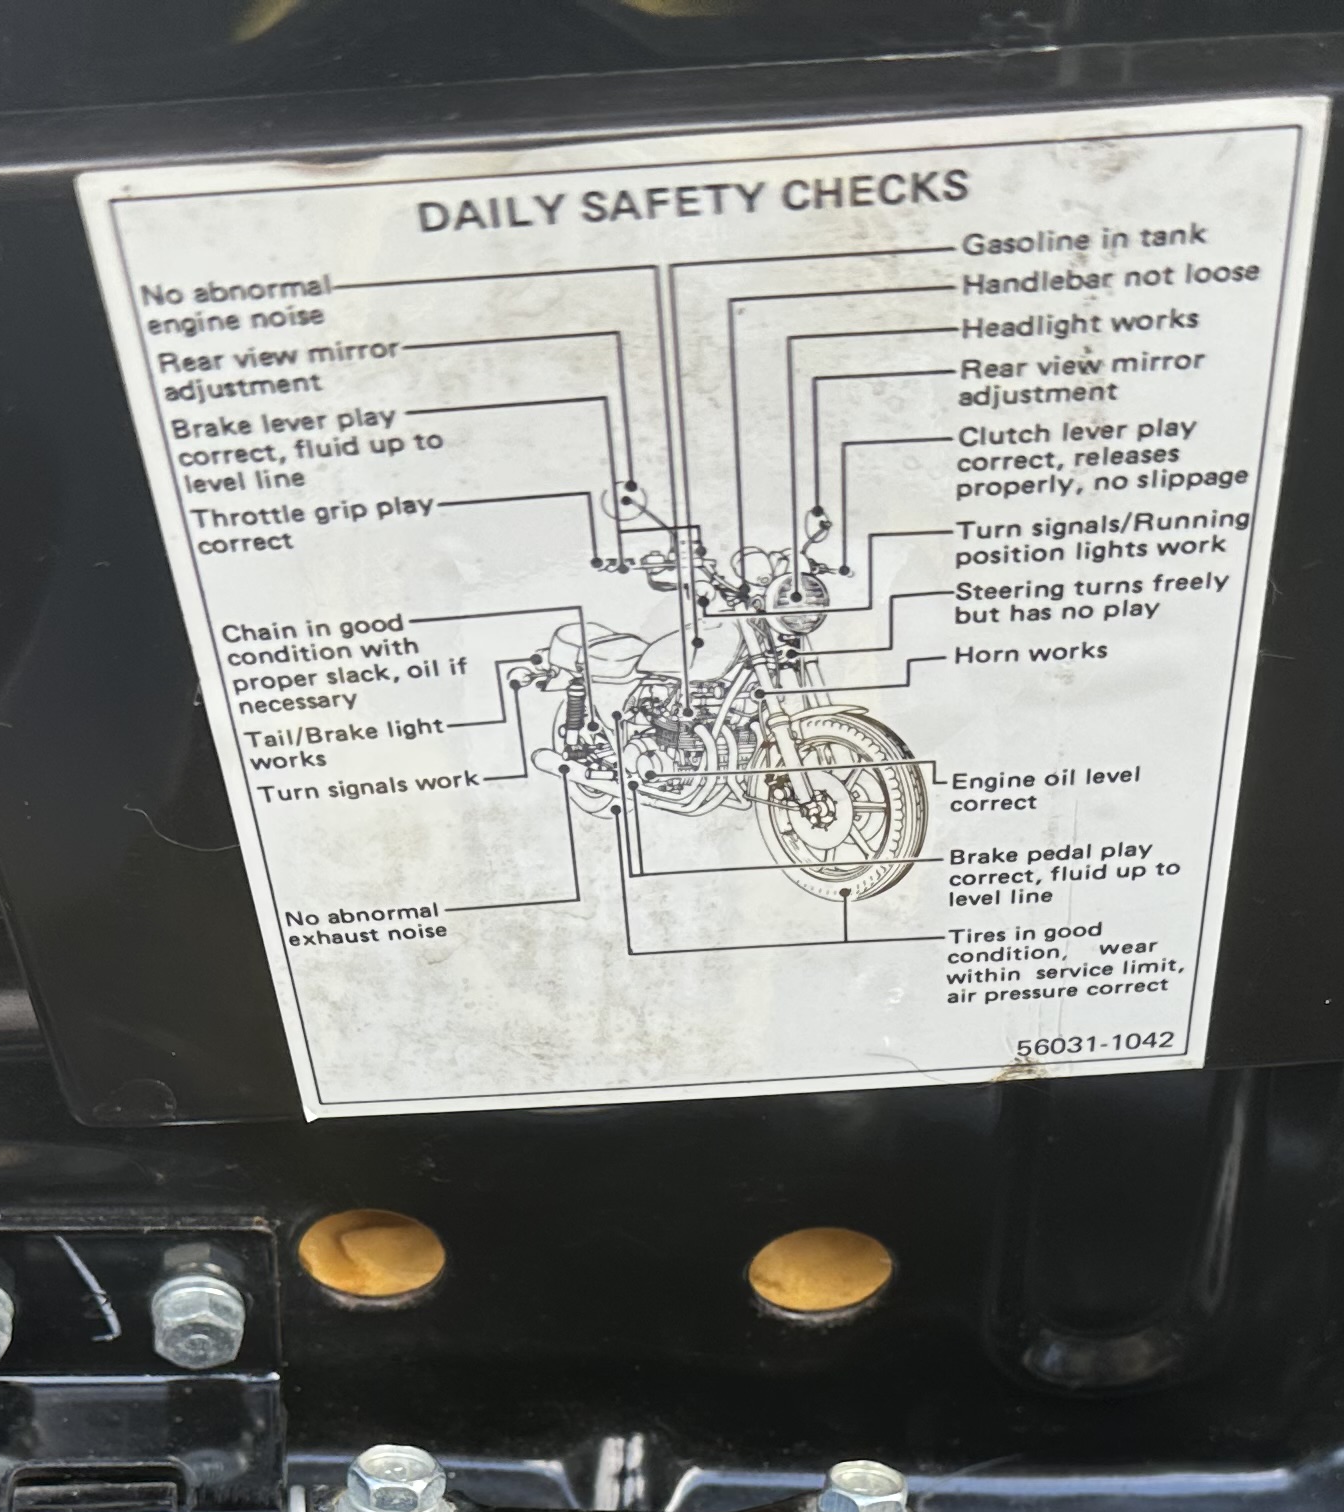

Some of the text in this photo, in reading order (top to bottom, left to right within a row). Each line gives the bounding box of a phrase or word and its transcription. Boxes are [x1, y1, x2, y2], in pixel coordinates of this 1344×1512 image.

[417, 169, 969, 233] DAILY SAFETY CHECKS
[962, 222, 1206, 257] Gasoline in tank
[140, 274, 334, 305] No abnormal
[963, 263, 1261, 295] Handlebar not loose
[149, 308, 325, 338] engine noise
[962, 307, 1199, 340] Headlight works
[158, 341, 399, 373] Rear view mirror
[961, 351, 1206, 380] Rear view mirror
[165, 374, 323, 404] adjustment
[958, 383, 1118, 410] adjustment
[171, 407, 396, 439] Brake lever play
[958, 417, 1198, 447] Clutch lever play
[178, 434, 444, 467] correct, fluid up to
[957, 446, 1180, 473] correct, releases
[184, 470, 305, 494] level line
[956, 468, 1249, 502] properly, no slippage
[189, 496, 434, 528] Throttle grip play
[955, 509, 1249, 541] Turn signals/Running
[197, 533, 294, 555] correct
[955, 534, 1226, 570] position lights work
[955, 571, 1230, 602] Steering turns freely
[955, 599, 1160, 625] but has no play
[221, 613, 404, 643] Chain in good
[227, 637, 420, 667] condition with
[955, 641, 1108, 665] Horn works
[232, 656, 468, 696] proper slack, oil if
[238, 693, 357, 715] necessary
[243, 718, 444, 748] Tail/Brake light
[249, 750, 327, 771] works
[256, 769, 480, 803] Turn signals work
[952, 765, 1140, 793] Engine oil level
[950, 795, 1037, 813] correct
[950, 841, 1153, 866] Brake pedal play
[949, 862, 1181, 887] correct, fluid up to
[949, 888, 1053, 907] level line
[284, 902, 439, 927] No abnormal
[288, 923, 447, 947] exhaust noise
[948, 921, 1103, 945] Tires in good
[947, 941, 1158, 965] condition, wear
[946, 957, 1185, 985] within service limit,
[947, 978, 1169, 1005] air pressure correct
[1017, 1031, 1175, 1057] 56031-1042
